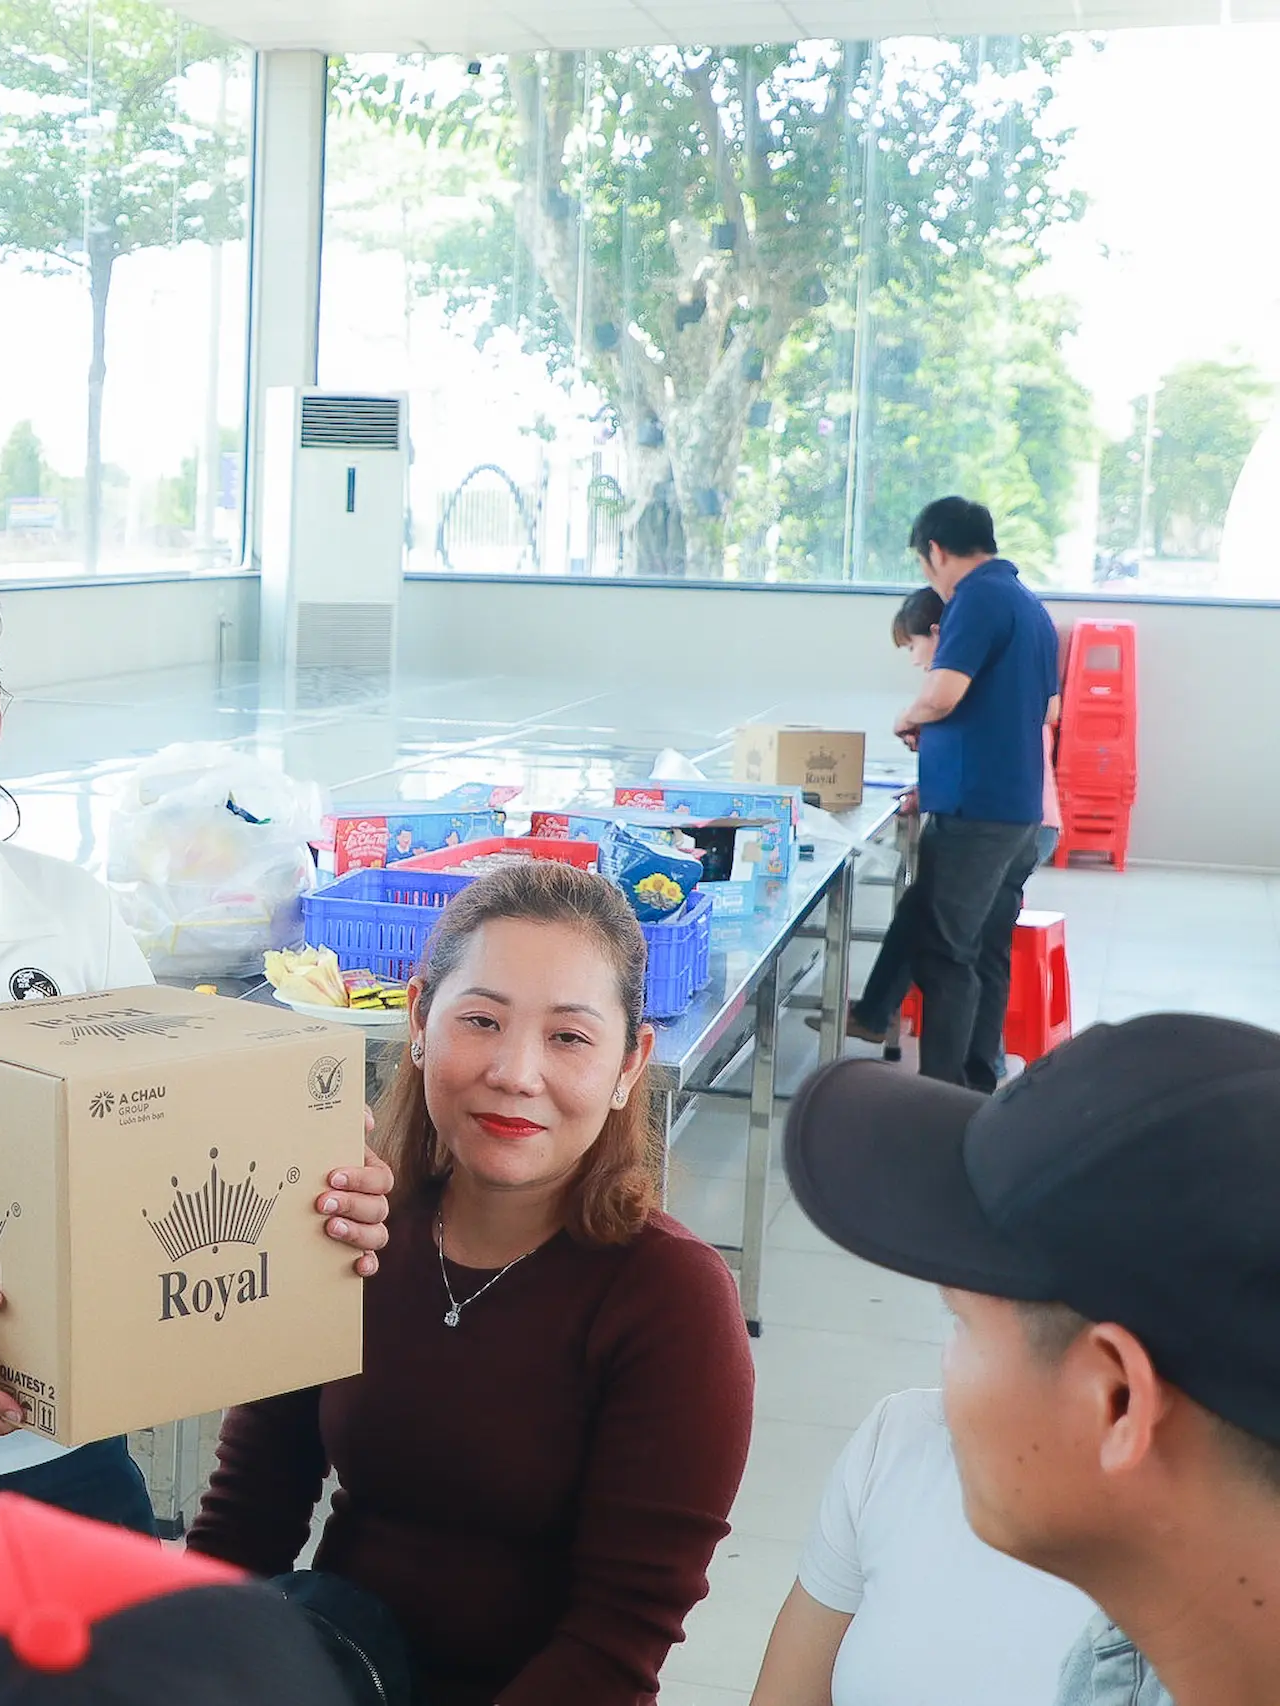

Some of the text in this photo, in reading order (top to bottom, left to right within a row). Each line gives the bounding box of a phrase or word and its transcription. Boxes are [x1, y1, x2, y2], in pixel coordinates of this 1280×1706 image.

[119, 1103, 149, 1115] GROUP
[120, 1086, 166, 1106] A CHAU
[158, 1251, 269, 1322] Royal
[0, 1364, 55, 1400] QUATEST 2
